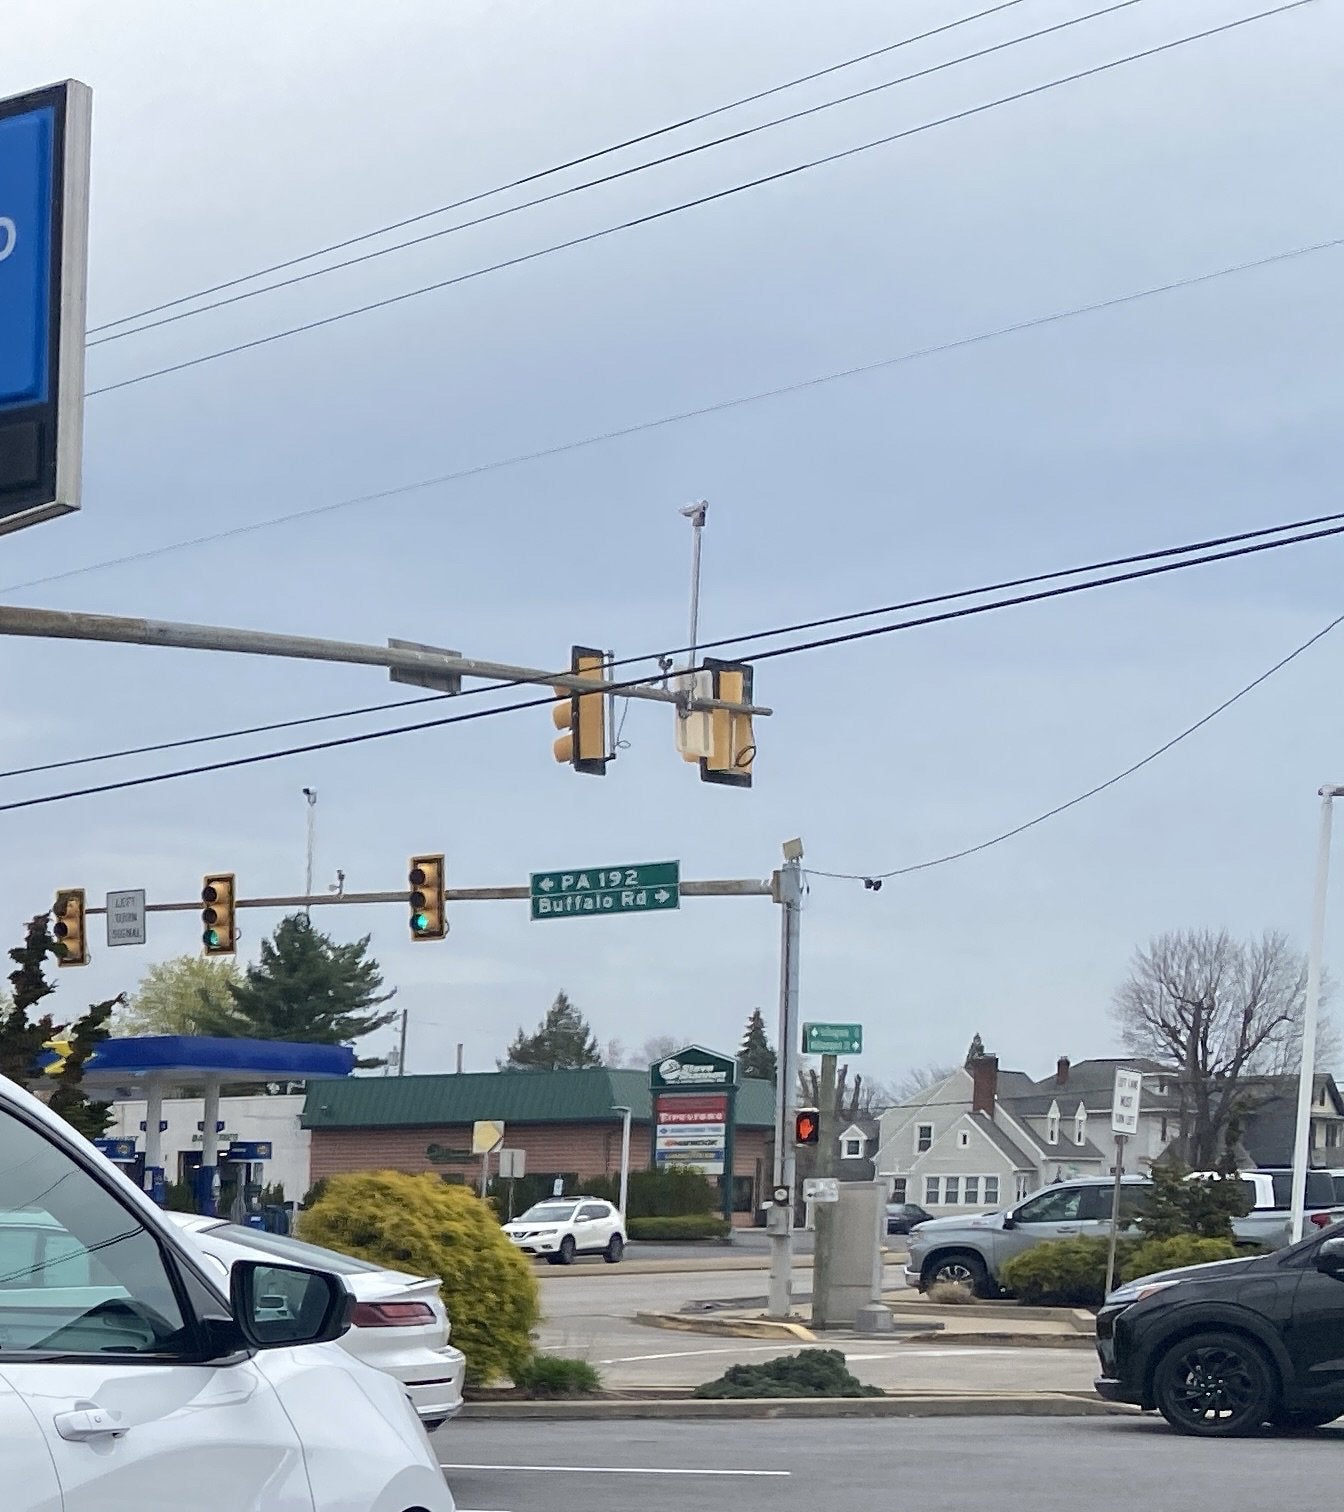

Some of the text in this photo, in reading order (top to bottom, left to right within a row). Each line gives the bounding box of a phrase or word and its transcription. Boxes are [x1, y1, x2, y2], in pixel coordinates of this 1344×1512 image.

[561, 869, 639, 891] PA 192
[538, 890, 647, 914] Buffalo Rd
